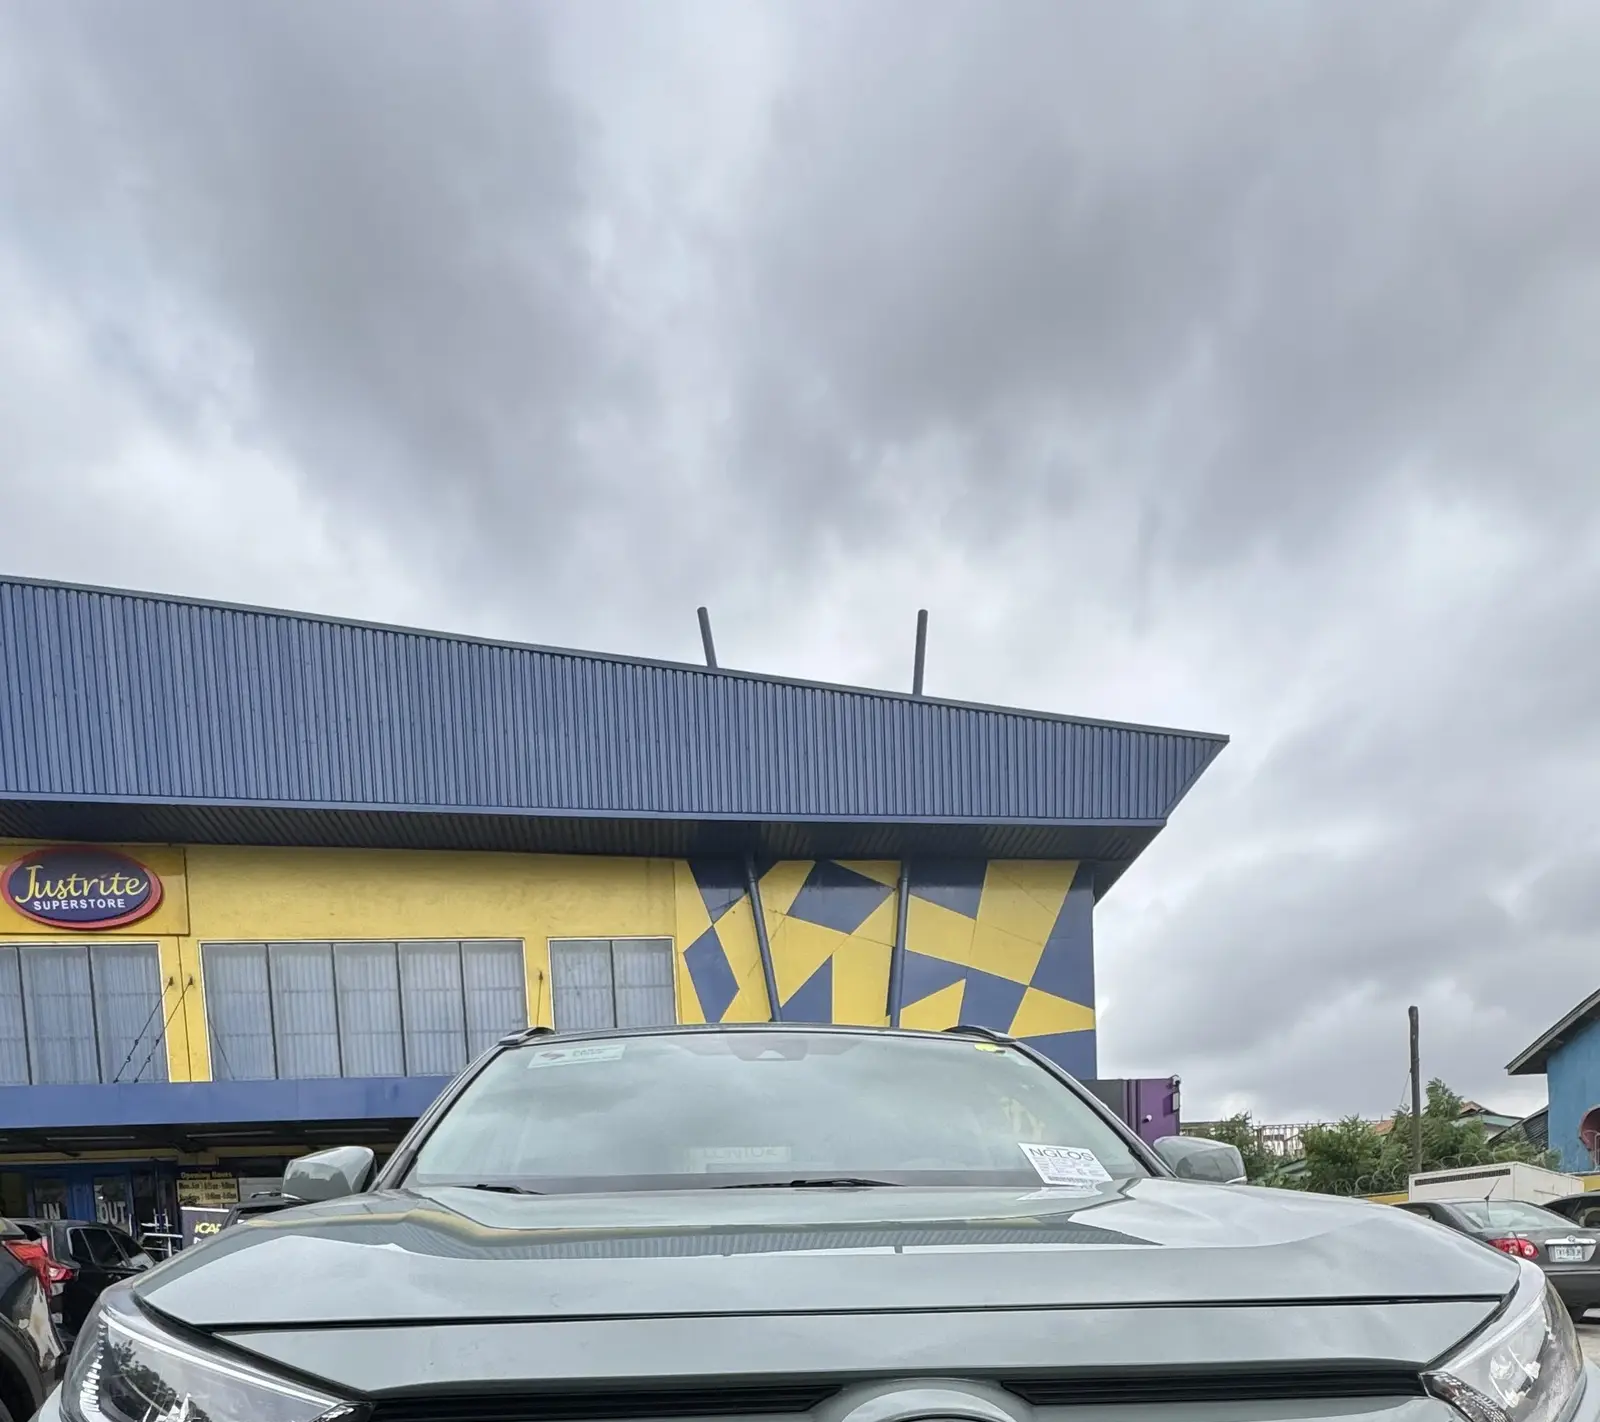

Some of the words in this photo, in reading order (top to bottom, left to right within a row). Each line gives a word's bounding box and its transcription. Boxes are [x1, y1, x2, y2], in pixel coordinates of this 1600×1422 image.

[15, 864, 148, 903] Justrite
[33, 898, 126, 911] SUPERSTORE
[1029, 1147, 1094, 1161] NGLOS
[42, 1202, 61, 1220] IN
[98, 1200, 126, 1225] OUT
